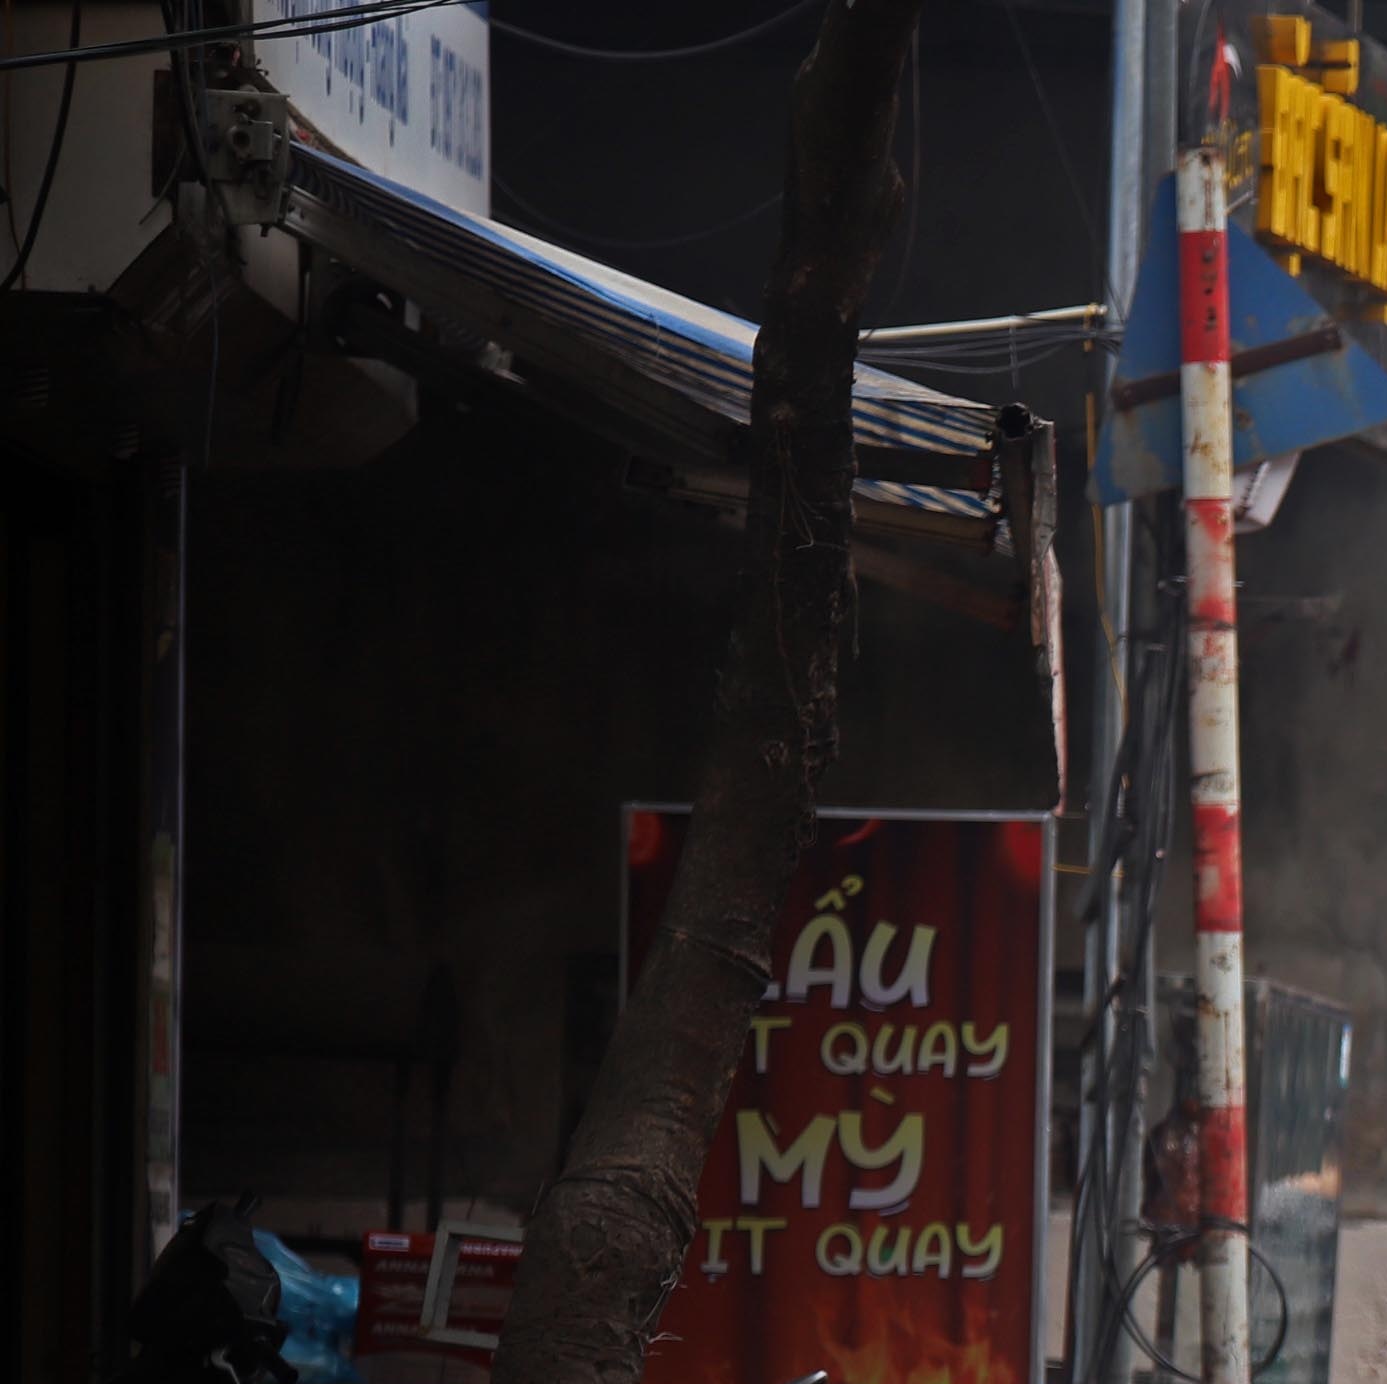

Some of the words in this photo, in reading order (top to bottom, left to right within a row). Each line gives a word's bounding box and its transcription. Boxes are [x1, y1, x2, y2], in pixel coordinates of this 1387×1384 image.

[764, 876, 937, 1010] ẨU
[820, 1020, 1010, 1079] QUAY
[702, 1216, 787, 1282] ỊT
[815, 1221, 1003, 1280] QUAY
